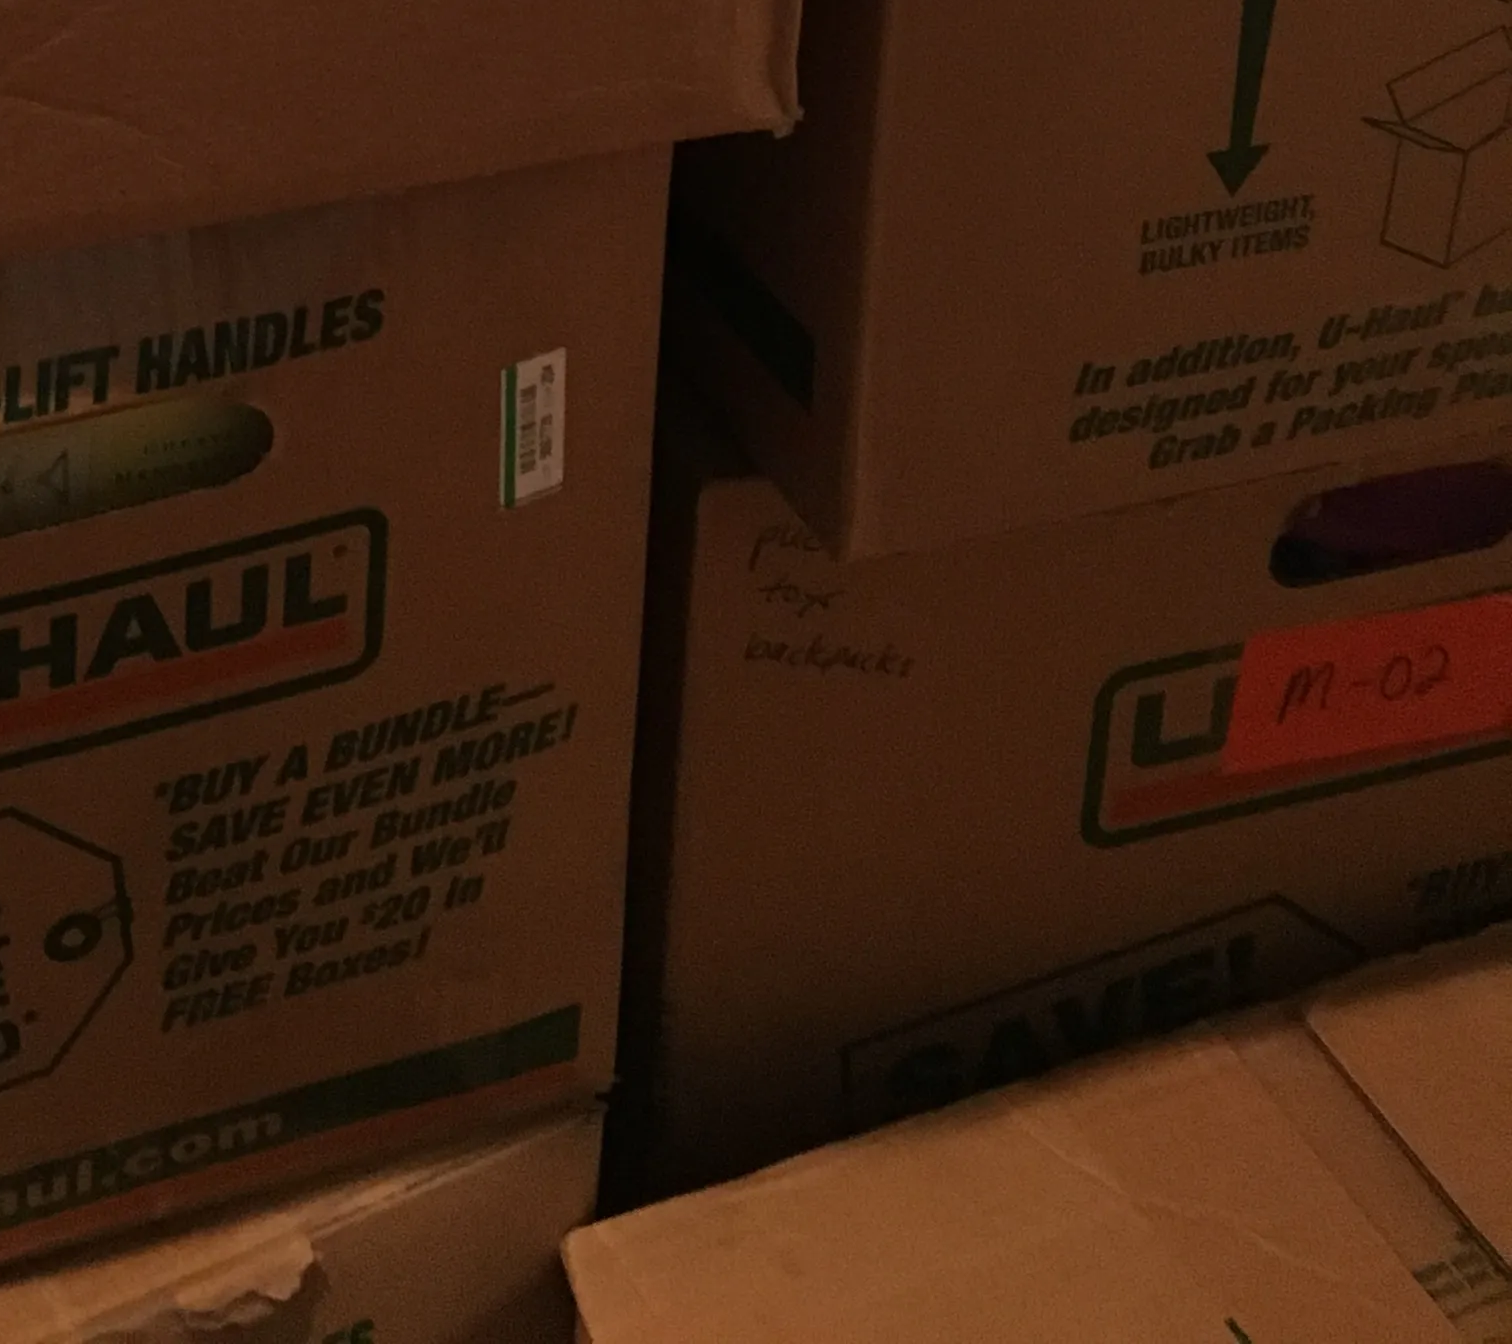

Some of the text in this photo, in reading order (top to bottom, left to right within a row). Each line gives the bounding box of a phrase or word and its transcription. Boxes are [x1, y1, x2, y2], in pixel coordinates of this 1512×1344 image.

[134, 287, 387, 394] HANDLES
[1264, 368, 1324, 404] for
[164, 701, 579, 863] SAVE EVEN MORE!
[275, 744, 309, 787] A
[164, 779, 518, 907] Beat Our Bundle
[162, 887, 301, 949] Prices
[311, 853, 399, 907] and
[160, 924, 433, 1034] FREE Boxes!
[161, 943, 258, 992] Give
[273, 917, 350, 960] You
